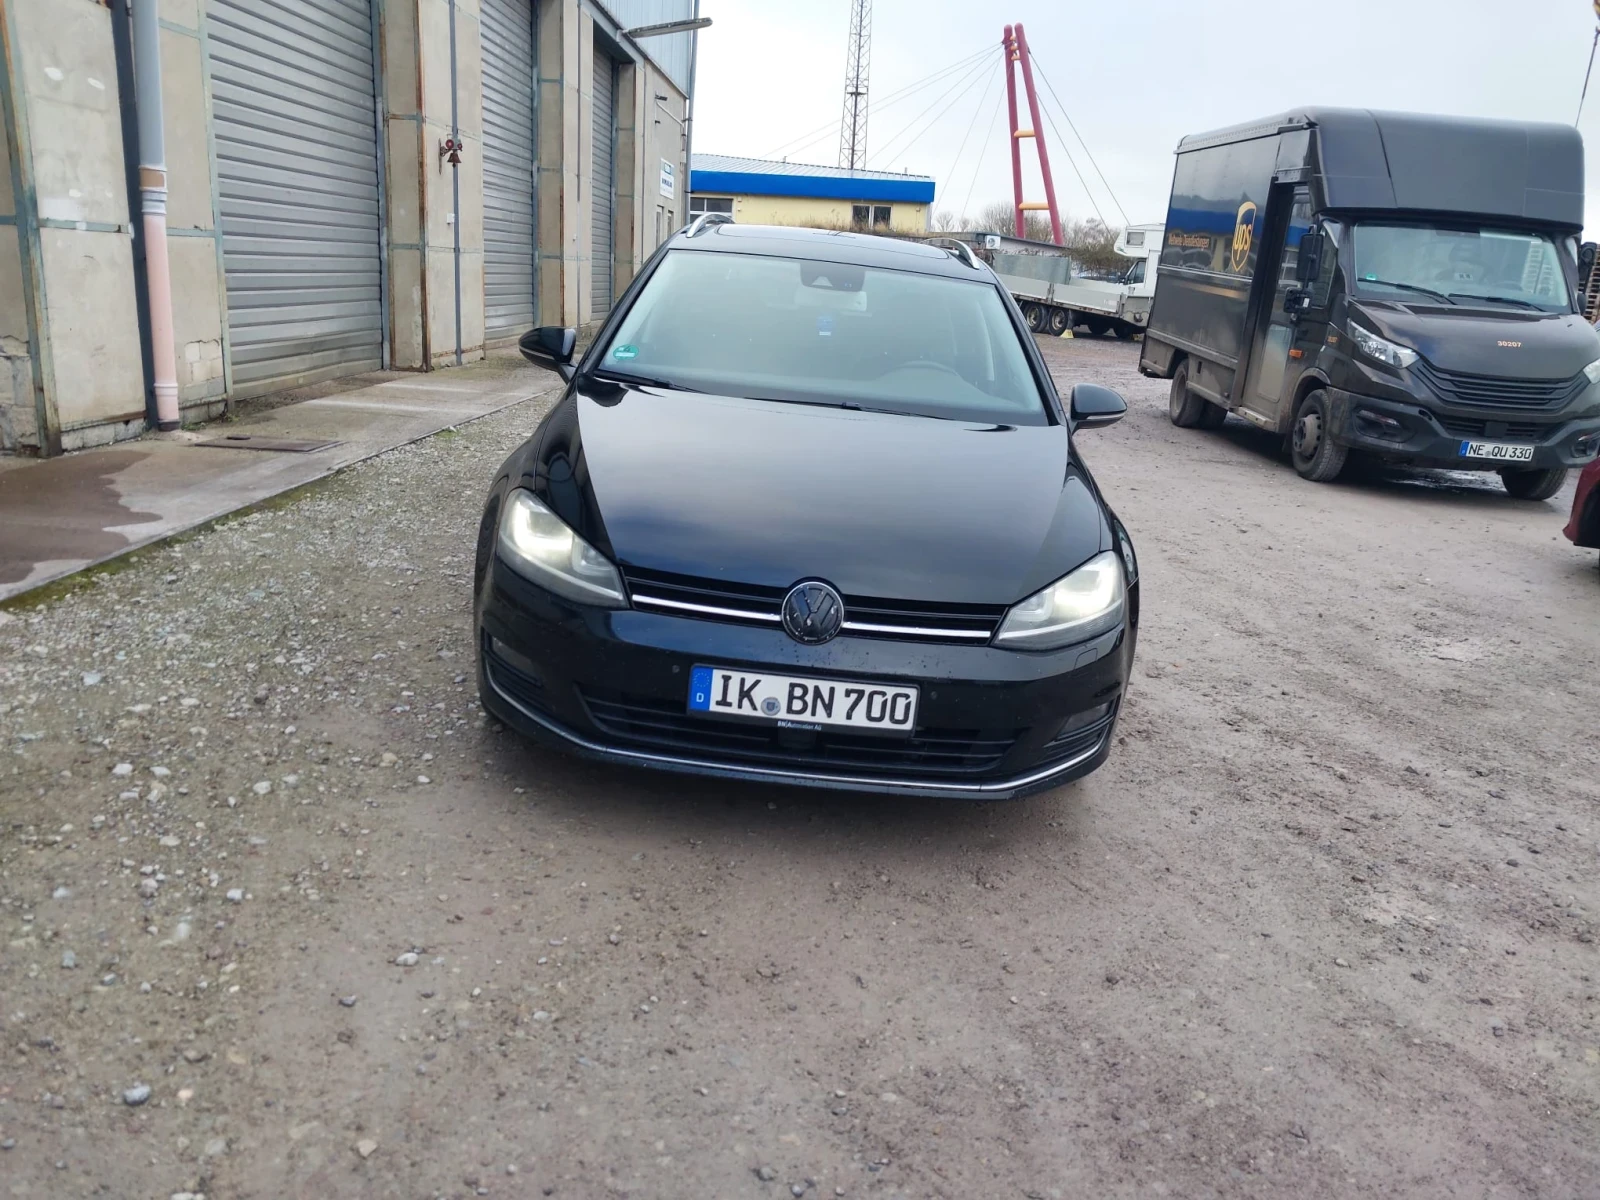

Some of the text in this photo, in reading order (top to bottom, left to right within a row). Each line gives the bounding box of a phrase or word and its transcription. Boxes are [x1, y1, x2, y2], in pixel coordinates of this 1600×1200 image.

[1232, 223, 1252, 261] ups
[1497, 340, 1522, 348] 30207
[1468, 443, 1486, 456] NE
[1491, 445, 1509, 458] QU
[1509, 447, 1532, 460] 330
[695, 692, 705, 703] D
[715, 674, 912, 726] IK BN 700
